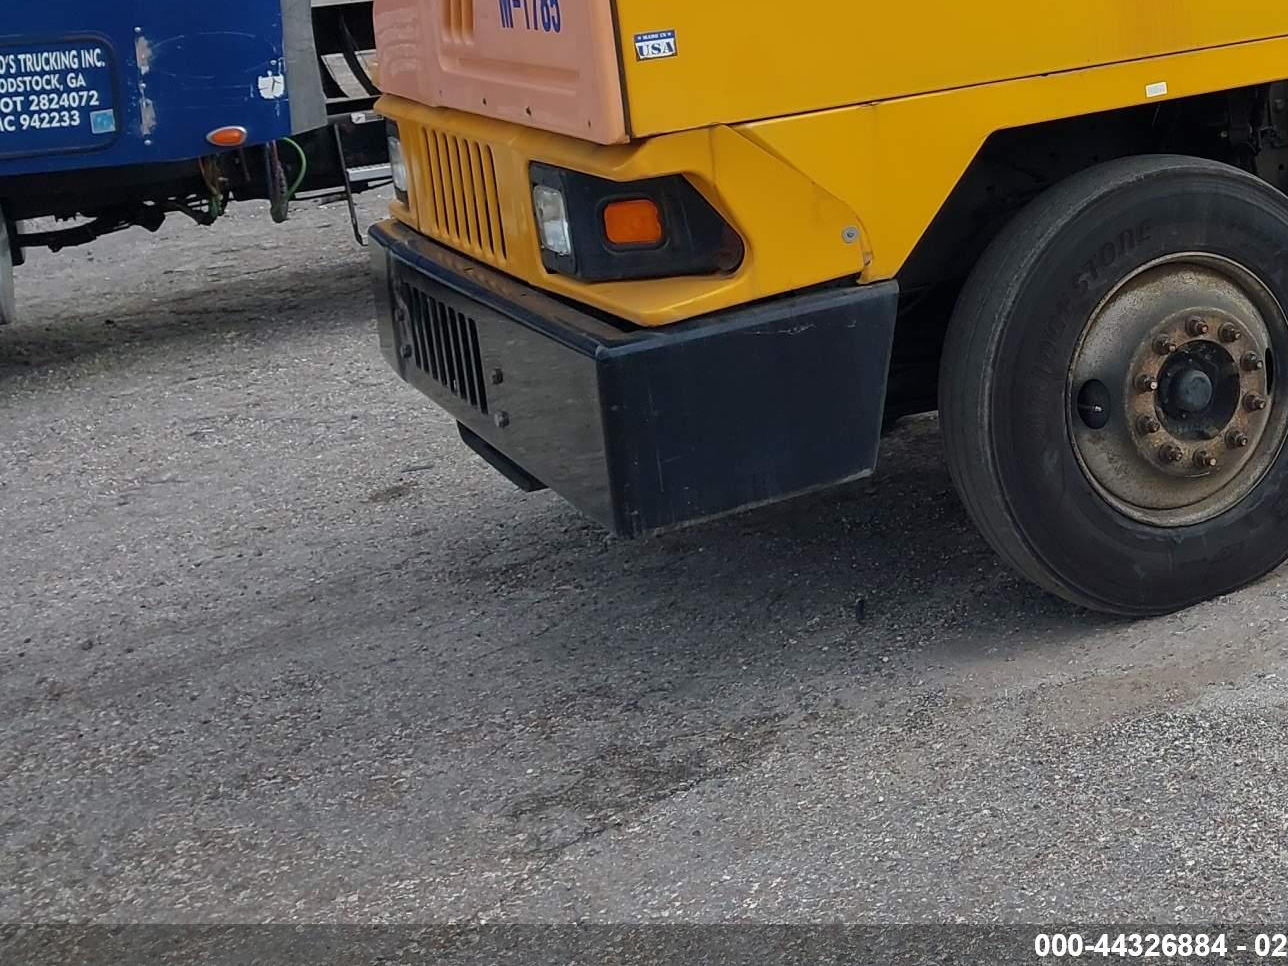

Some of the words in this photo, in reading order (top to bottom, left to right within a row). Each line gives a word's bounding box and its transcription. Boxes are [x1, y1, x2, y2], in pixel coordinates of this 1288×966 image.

[638, 42, 674, 56] USA
[18, 50, 79, 72] TRUCKING
[81, 48, 105, 67] INC.
[67, 73, 86, 88] GA
[29, 90, 99, 110] 2824072
[20, 109, 81, 130] 942233
